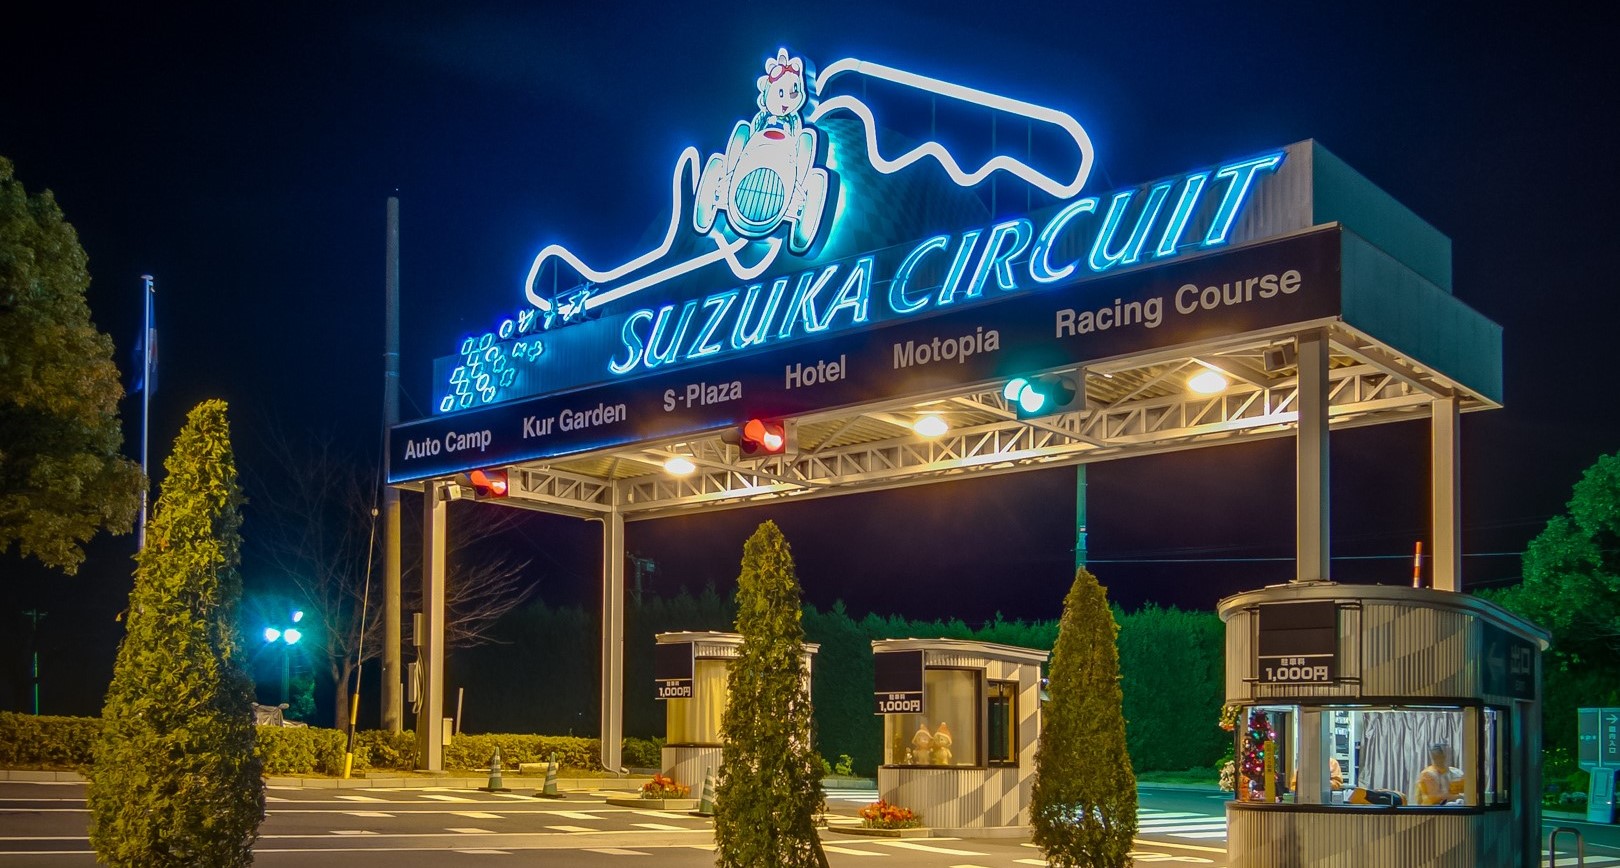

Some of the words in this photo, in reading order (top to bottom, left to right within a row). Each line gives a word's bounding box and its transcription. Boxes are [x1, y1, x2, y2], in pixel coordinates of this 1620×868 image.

[608, 254, 876, 376] SUZUKA
[888, 150, 1288, 315] CIRCUIT
[1056, 296, 1163, 338] Racing
[1175, 269, 1302, 314] Course
[893, 326, 1000, 369] Motopia
[785, 354, 846, 389] Hotel
[523, 415, 554, 439] Kur
[559, 402, 627, 432] Garden
[404, 438, 441, 460] Auto
[445, 429, 492, 452] Camp
[1265, 666, 1328, 681] 1,000円
[658, 686, 691, 698] 1,000円
[879, 700, 920, 712] 1,000円
